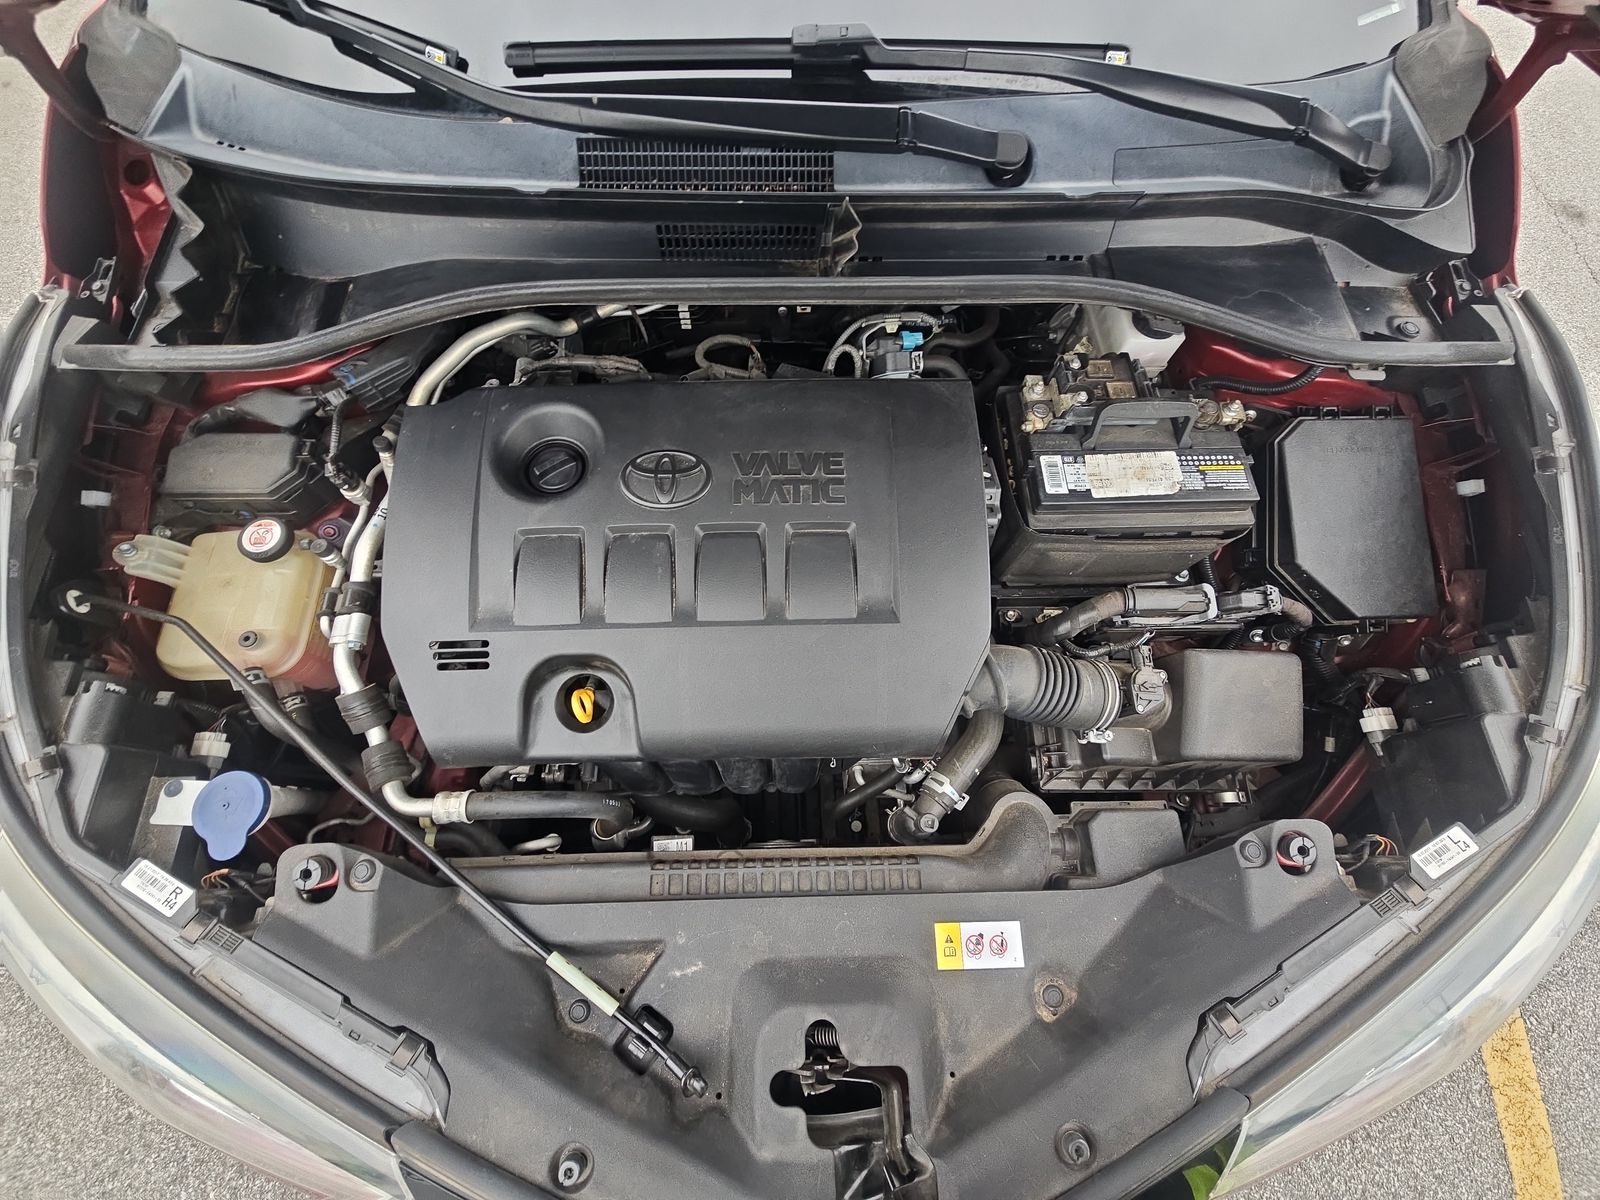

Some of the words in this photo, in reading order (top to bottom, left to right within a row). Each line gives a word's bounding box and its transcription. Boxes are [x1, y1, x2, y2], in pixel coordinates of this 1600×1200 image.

[731, 451, 846, 477] VALVE
[731, 477, 847, 506] MATIC
[1447, 835, 1460, 844] L
[1457, 840, 1470, 852] L4
[169, 886, 183, 900] R
[162, 896, 177, 910] H4
